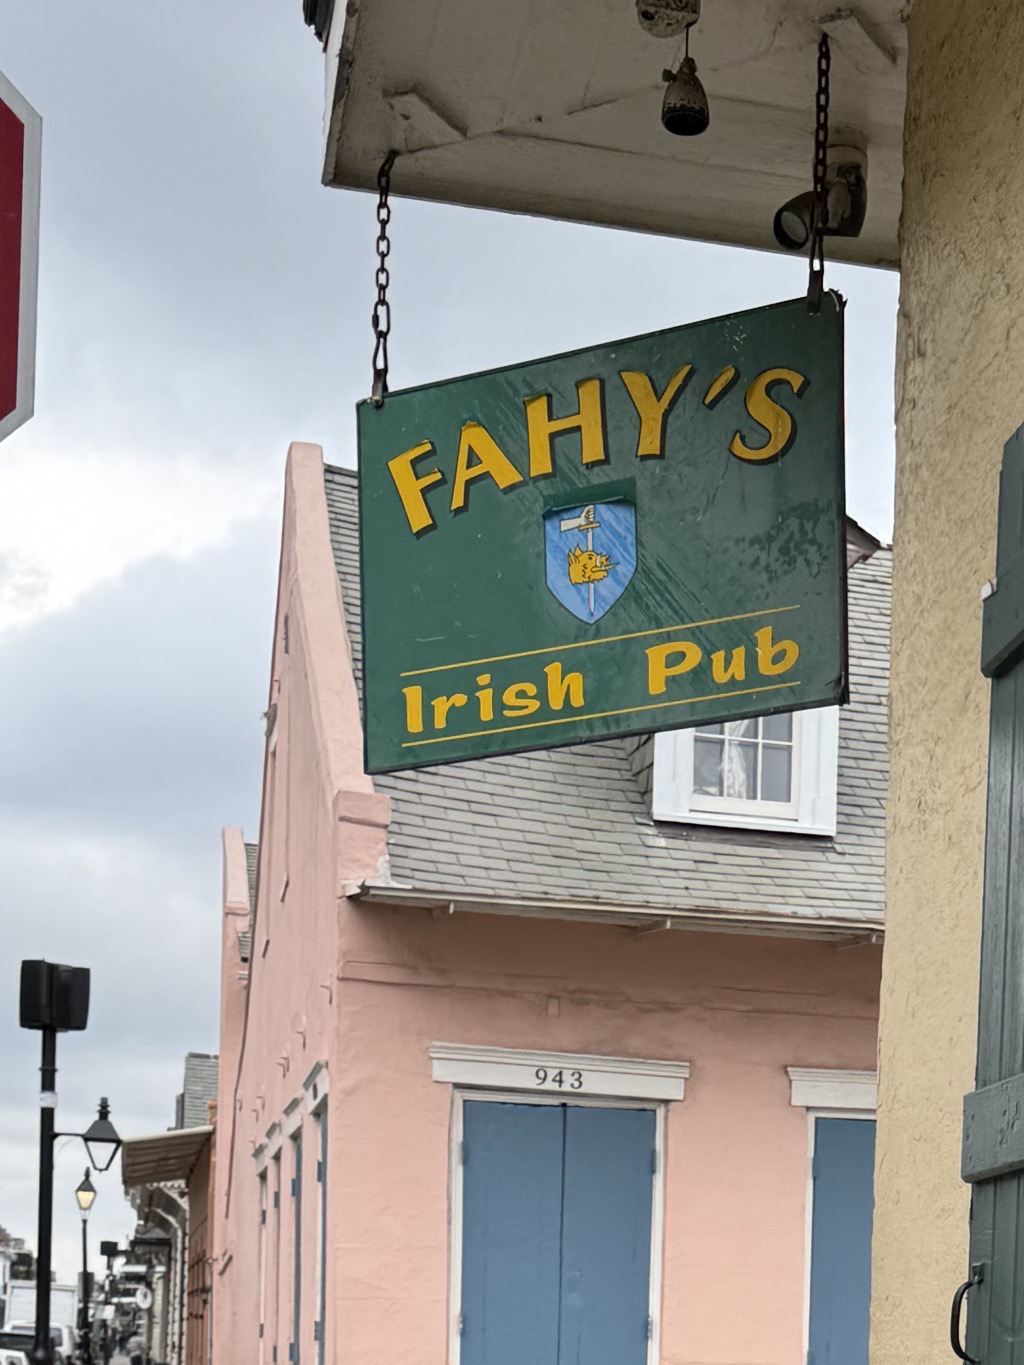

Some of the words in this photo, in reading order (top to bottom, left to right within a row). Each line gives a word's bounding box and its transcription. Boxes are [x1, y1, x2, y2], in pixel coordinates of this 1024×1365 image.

[387, 363, 806, 535] FAHY'S
[402, 661, 586, 733] Irish
[645, 625, 801, 696] Pub
[535, 1067, 583, 1090] 943
